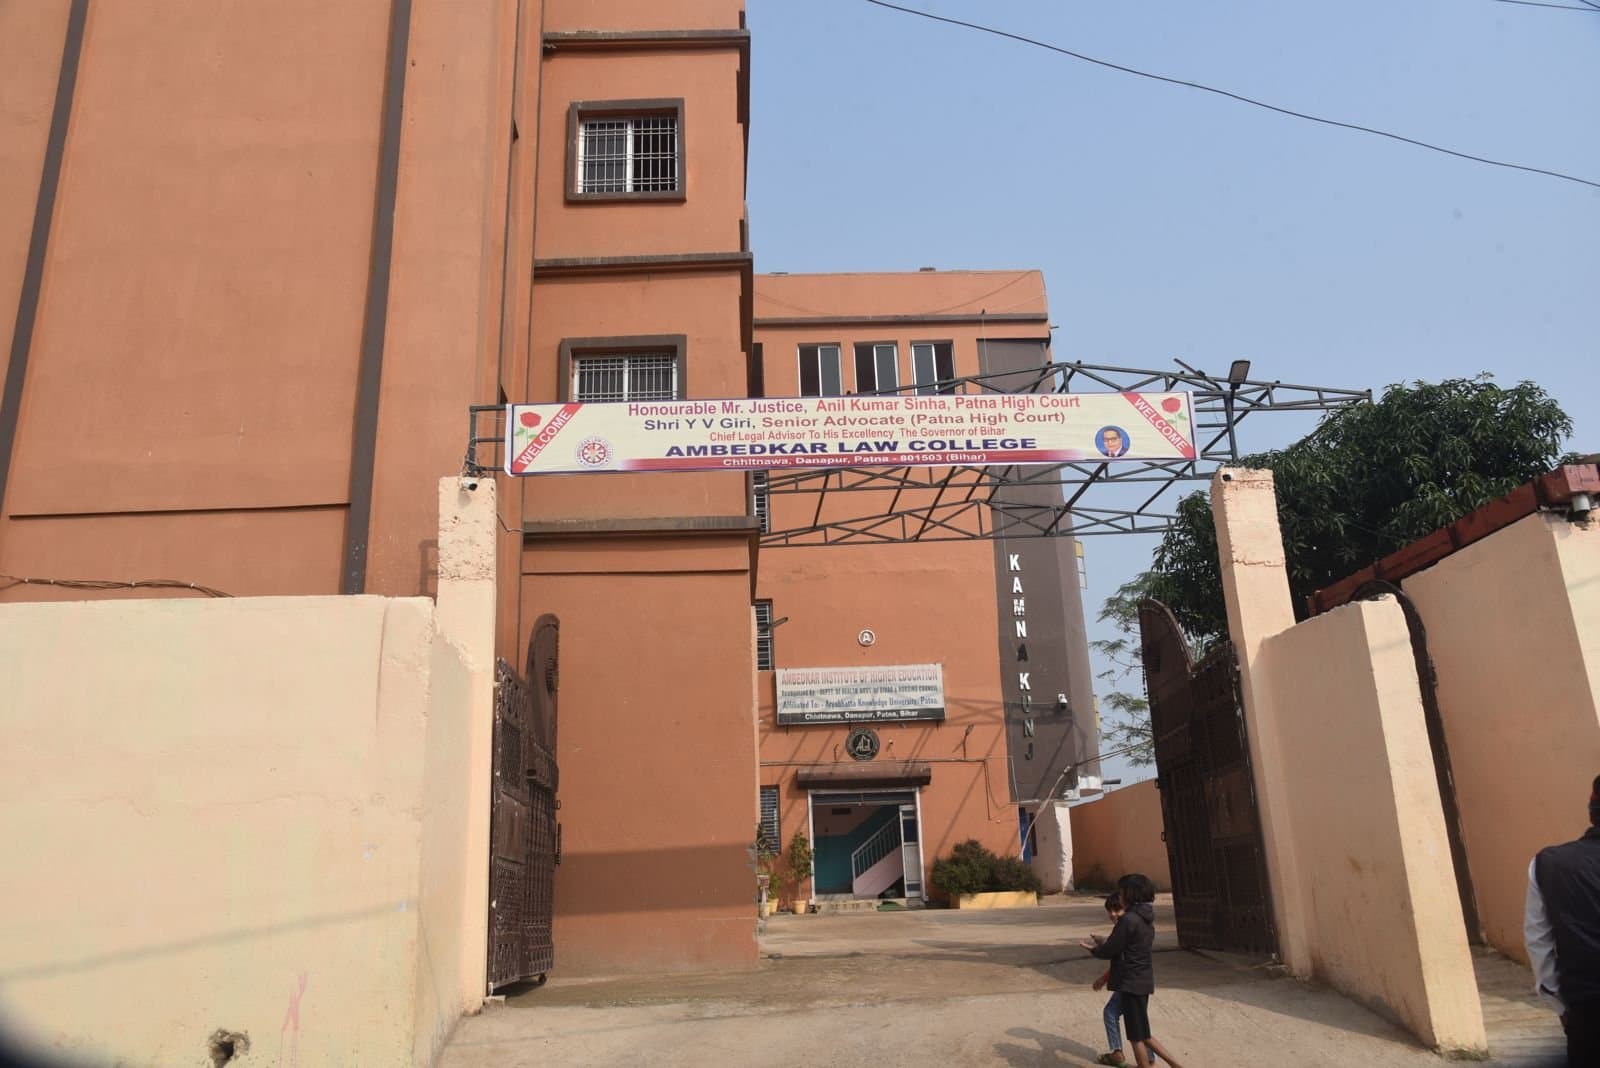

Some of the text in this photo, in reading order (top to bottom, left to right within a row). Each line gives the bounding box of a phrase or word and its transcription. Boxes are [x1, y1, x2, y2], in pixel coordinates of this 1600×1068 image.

[628, 395, 1080, 417] Honourable Mr. Justice, Anil Kumar Sinha, Patna High Court
[644, 412, 1065, 431] Shri Y V Giri, Senior Advocate (Patna High Court)
[1134, 398, 1188, 452] WELCOME
[517, 409, 572, 465] WELCOME
[709, 426, 1006, 443] Chief Legal Advisor To His Excellency The Governor of Bihar
[665, 438, 1037, 457] AMBEDKAR LAW COLLEGE
[723, 457, 792, 467] Chhitnawa,
[795, 456, 850, 466] Danapur,
[854, 455, 889, 464] Patna
[900, 454, 942, 463] 801503
[945, 452, 986, 463] (Bihar)
[1009, 553, 1036, 761] KAMNA KUNJ
[822, 670, 858, 685] INSTITUTE
[898, 667, 938, 682] EDUCATION
